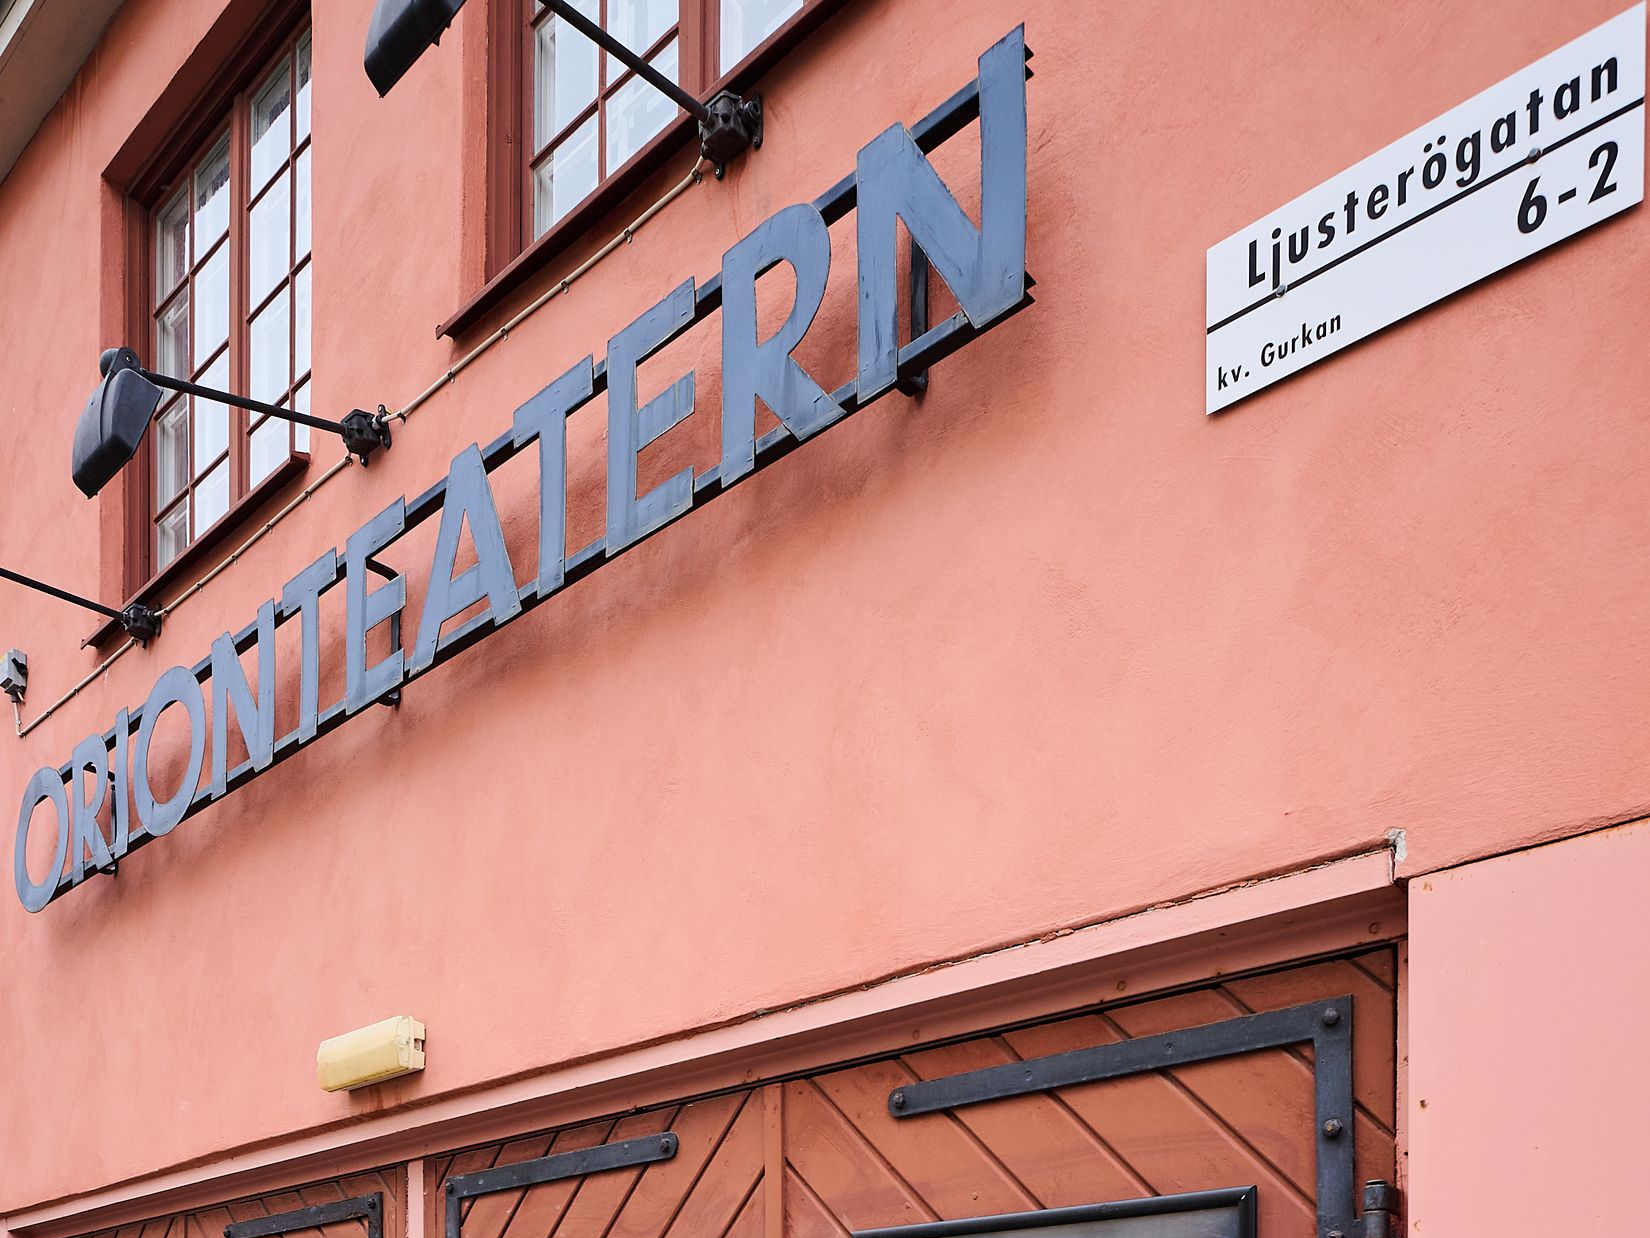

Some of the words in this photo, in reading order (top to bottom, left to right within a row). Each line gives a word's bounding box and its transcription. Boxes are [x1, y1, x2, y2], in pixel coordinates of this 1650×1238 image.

[1247, 55, 1619, 290] Ljusterögatan
[1516, 141, 1618, 234] 6-2
[1217, 363, 1250, 391] kv.
[1260, 310, 1343, 368] Gurkan
[15, 23, 1026, 913] ORIONTEATERN
